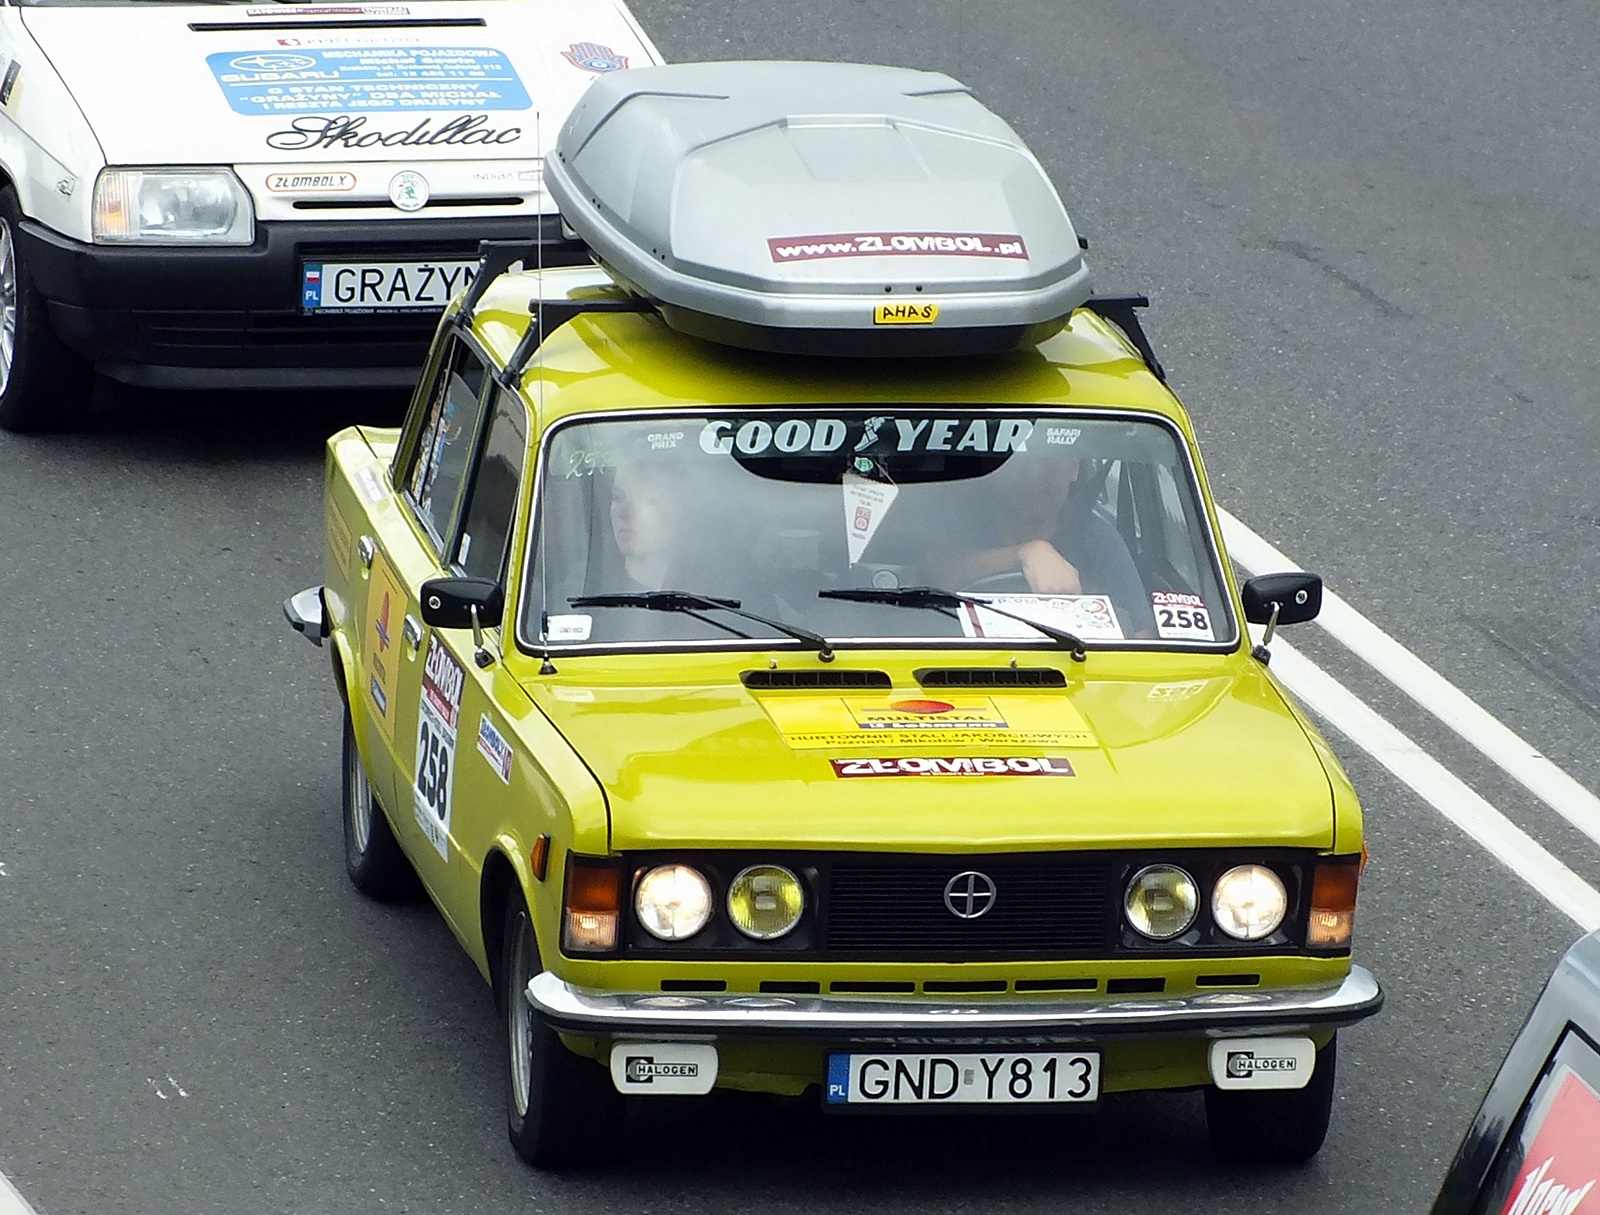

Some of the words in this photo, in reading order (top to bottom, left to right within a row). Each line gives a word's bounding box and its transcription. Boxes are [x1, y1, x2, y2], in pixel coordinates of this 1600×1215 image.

[410, 49, 500, 57] POJAZDOWA
[220, 70, 340, 82] SUBARU
[289, 85, 345, 93] STAN
[349, 83, 480, 92] TECHNICZNY
[370, 91, 416, 99] DBA
[421, 90, 503, 99] MICHAŁ
[274, 100, 343, 109] RESZTA
[346, 98, 395, 107] JEGO
[265, 115, 522, 151] Skodillac
[275, 175, 336, 189] ZŁOMBOL
[336, 175, 348, 187] X
[305, 290, 319, 301] PL
[646, 432, 684, 442] GRAND
[699, 419, 847, 455] GOOD
[894, 418, 1036, 453] YEAR
[1046, 427, 1081, 438] SAFARI
[651, 440, 679, 450] PRIX
[1046, 436, 1077, 445] RALLY
[1159, 609, 1209, 631] 258
[790, 733, 893, 741] HURTOWNIE
[417, 720, 449, 821] 258
[835, 758, 1069, 774] ZŁOMBOL
[638, 1065, 696, 1075] HALOGEN
[1238, 1060, 1294, 1069] HALOGEN
[859, 1058, 960, 1100] GND
[979, 1057, 1093, 1100] Y813
[829, 1084, 846, 1097] PL
